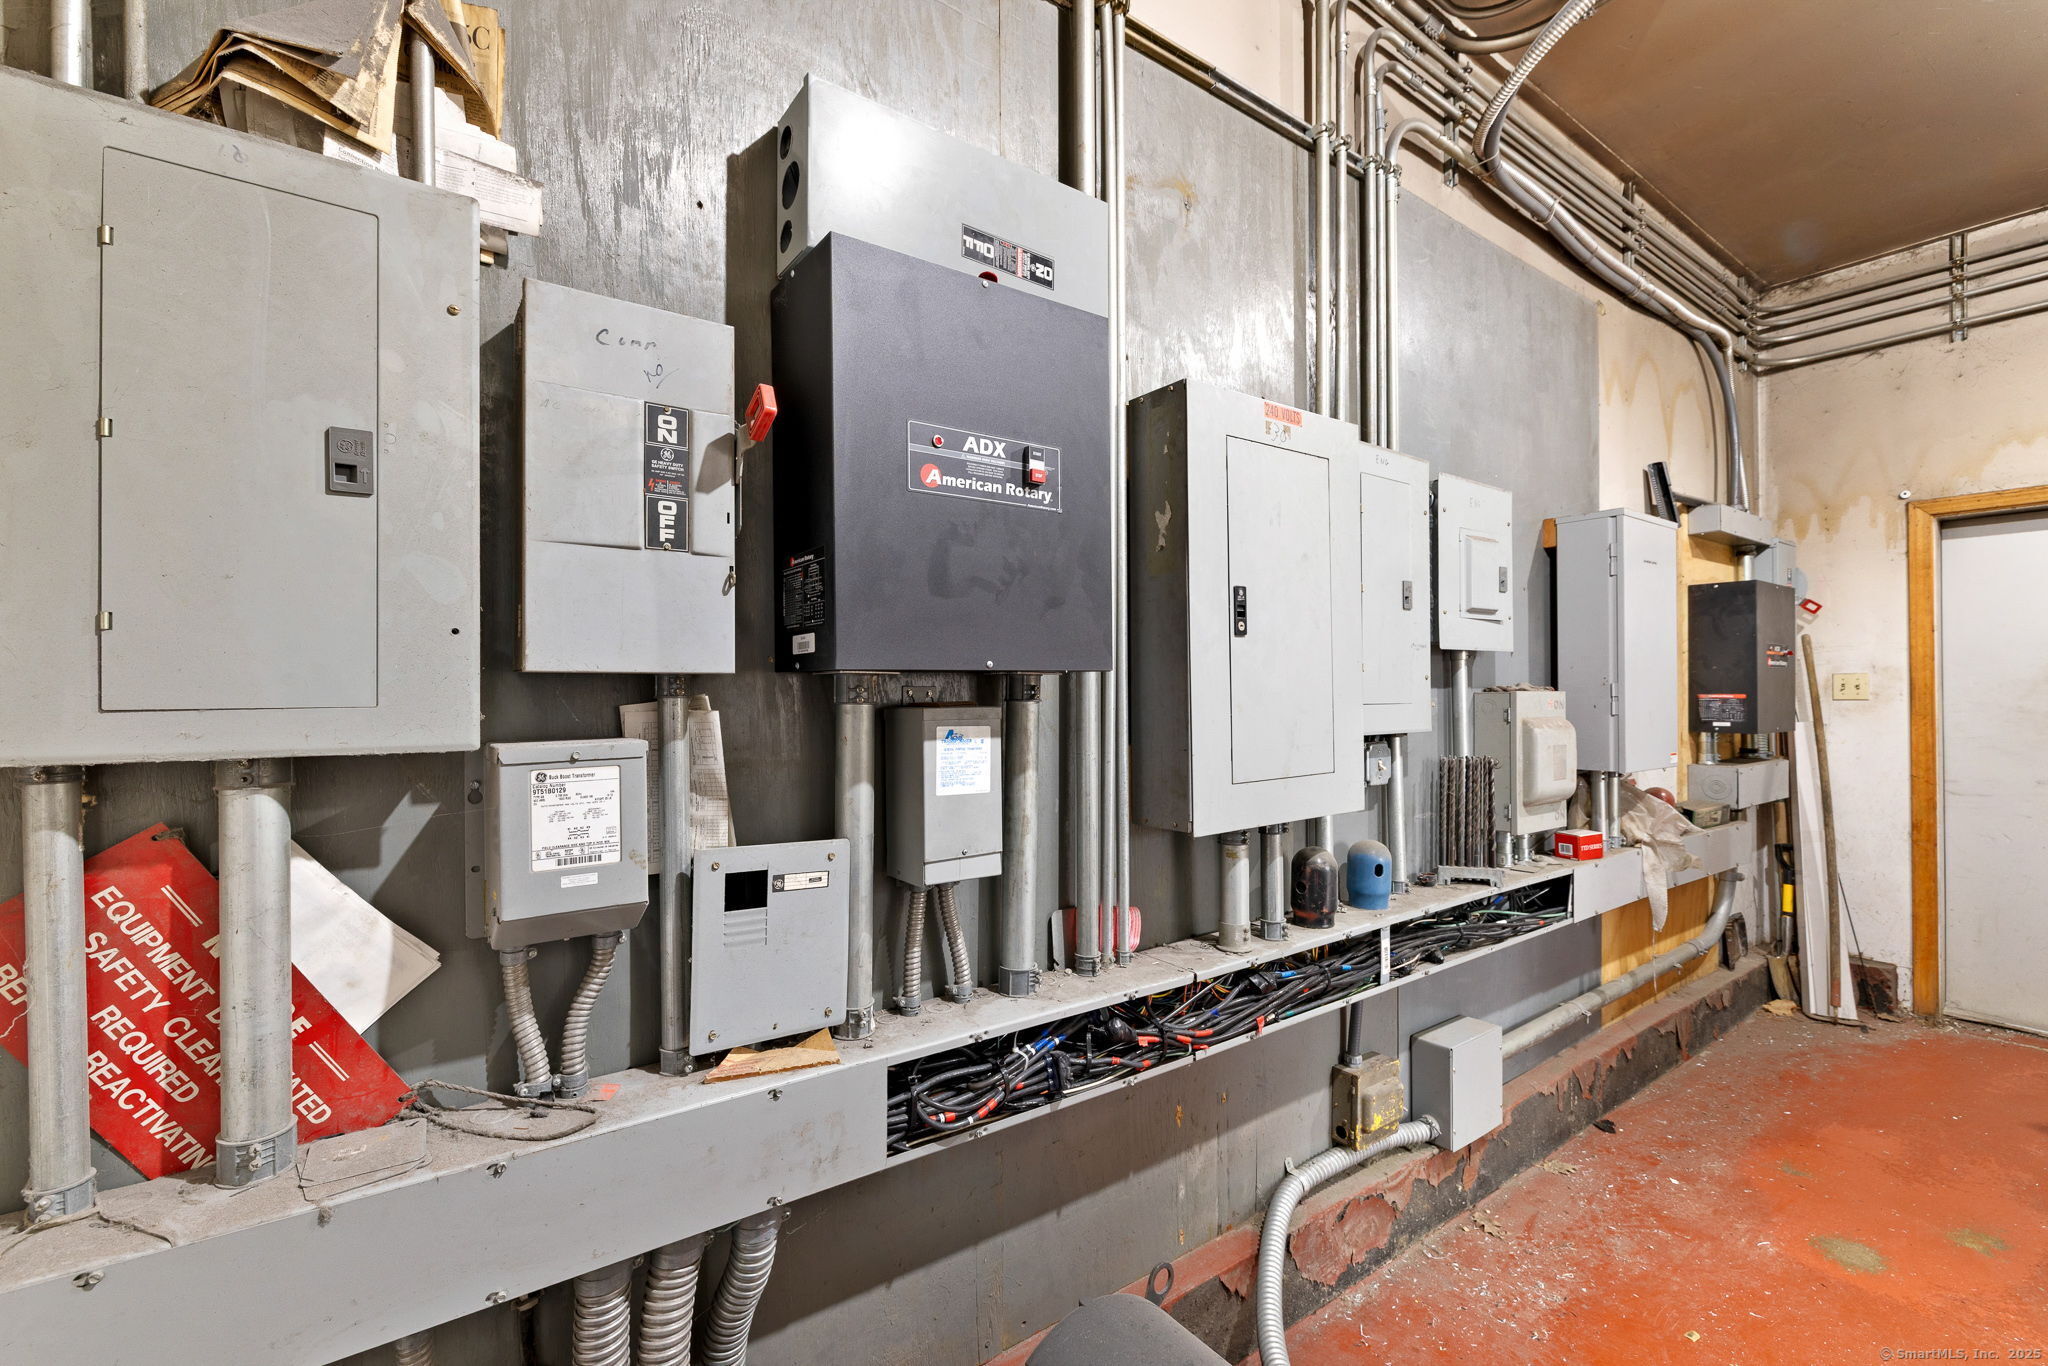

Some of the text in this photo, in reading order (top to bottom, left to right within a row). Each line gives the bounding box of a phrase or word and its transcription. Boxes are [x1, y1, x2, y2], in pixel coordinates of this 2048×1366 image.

[657, 414, 678, 444] ON
[1265, 403, 1301, 426] 240 VOLTS
[962, 436, 1007, 458] ADX
[926, 468, 1002, 494] American
[1005, 483, 1053, 504] Rotary
[658, 500, 678, 542] OFF
[90, 885, 216, 1001] EQUIPMENT
[85, 931, 171, 1014] SAFETY
[90, 1004, 200, 1104] REQUIRED
[87, 1050, 217, 1170] REACTIVATIN
